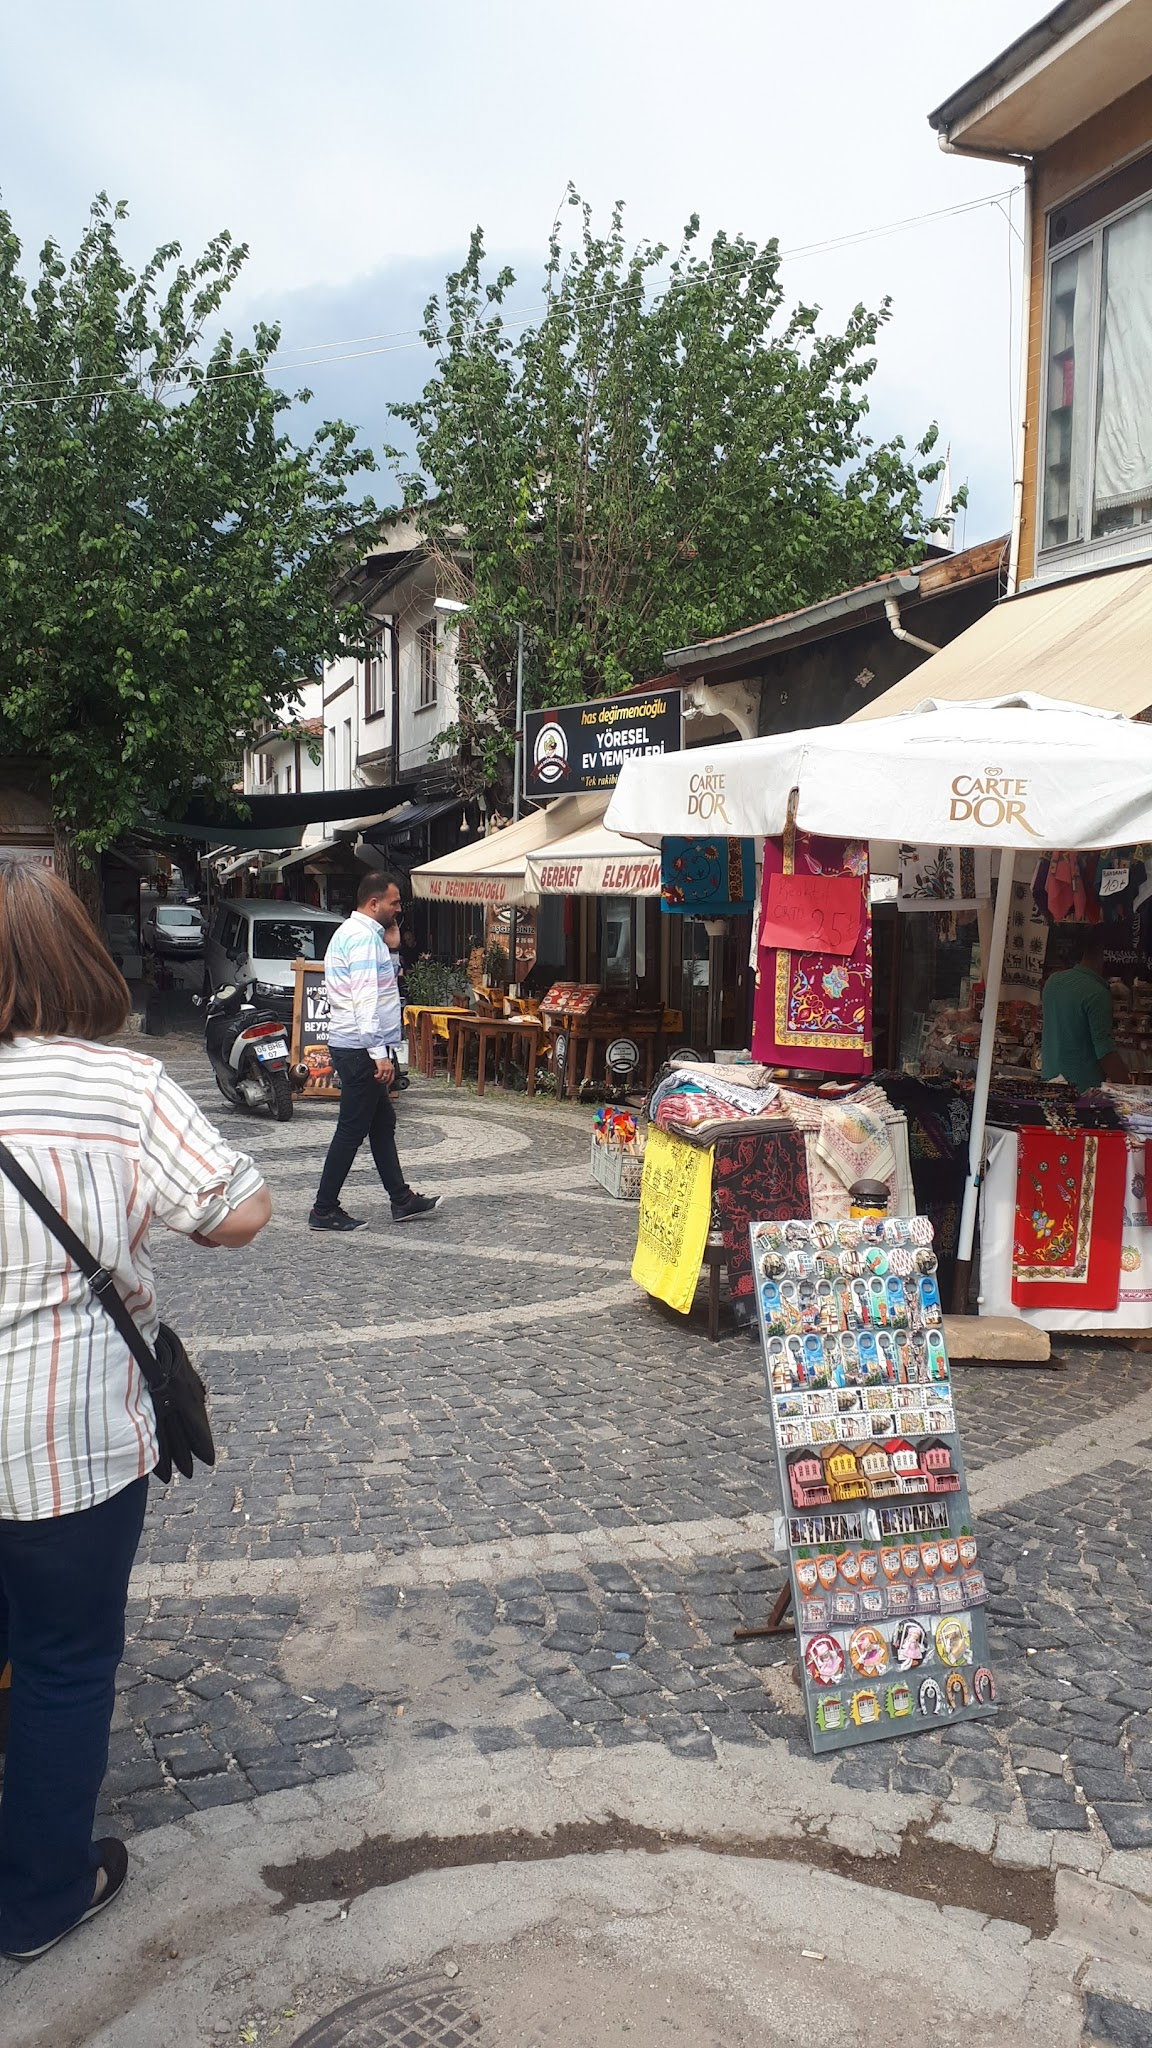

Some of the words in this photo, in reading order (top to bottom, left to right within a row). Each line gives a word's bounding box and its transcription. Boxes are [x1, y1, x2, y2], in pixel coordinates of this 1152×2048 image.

[581, 710, 597, 726] has
[598, 698, 667, 725] değirmencioğlu
[596, 727, 650, 749] YÖRESEL
[582, 752, 598, 769] EV
[689, 773, 726, 794] CARTE
[951, 775, 1029, 800] CARTE
[688, 790, 733, 825] D'OR
[949, 795, 1045, 838] D'OR
[540, 865, 583, 887] BEREKET
[267, 1050, 278, 1058] 07
